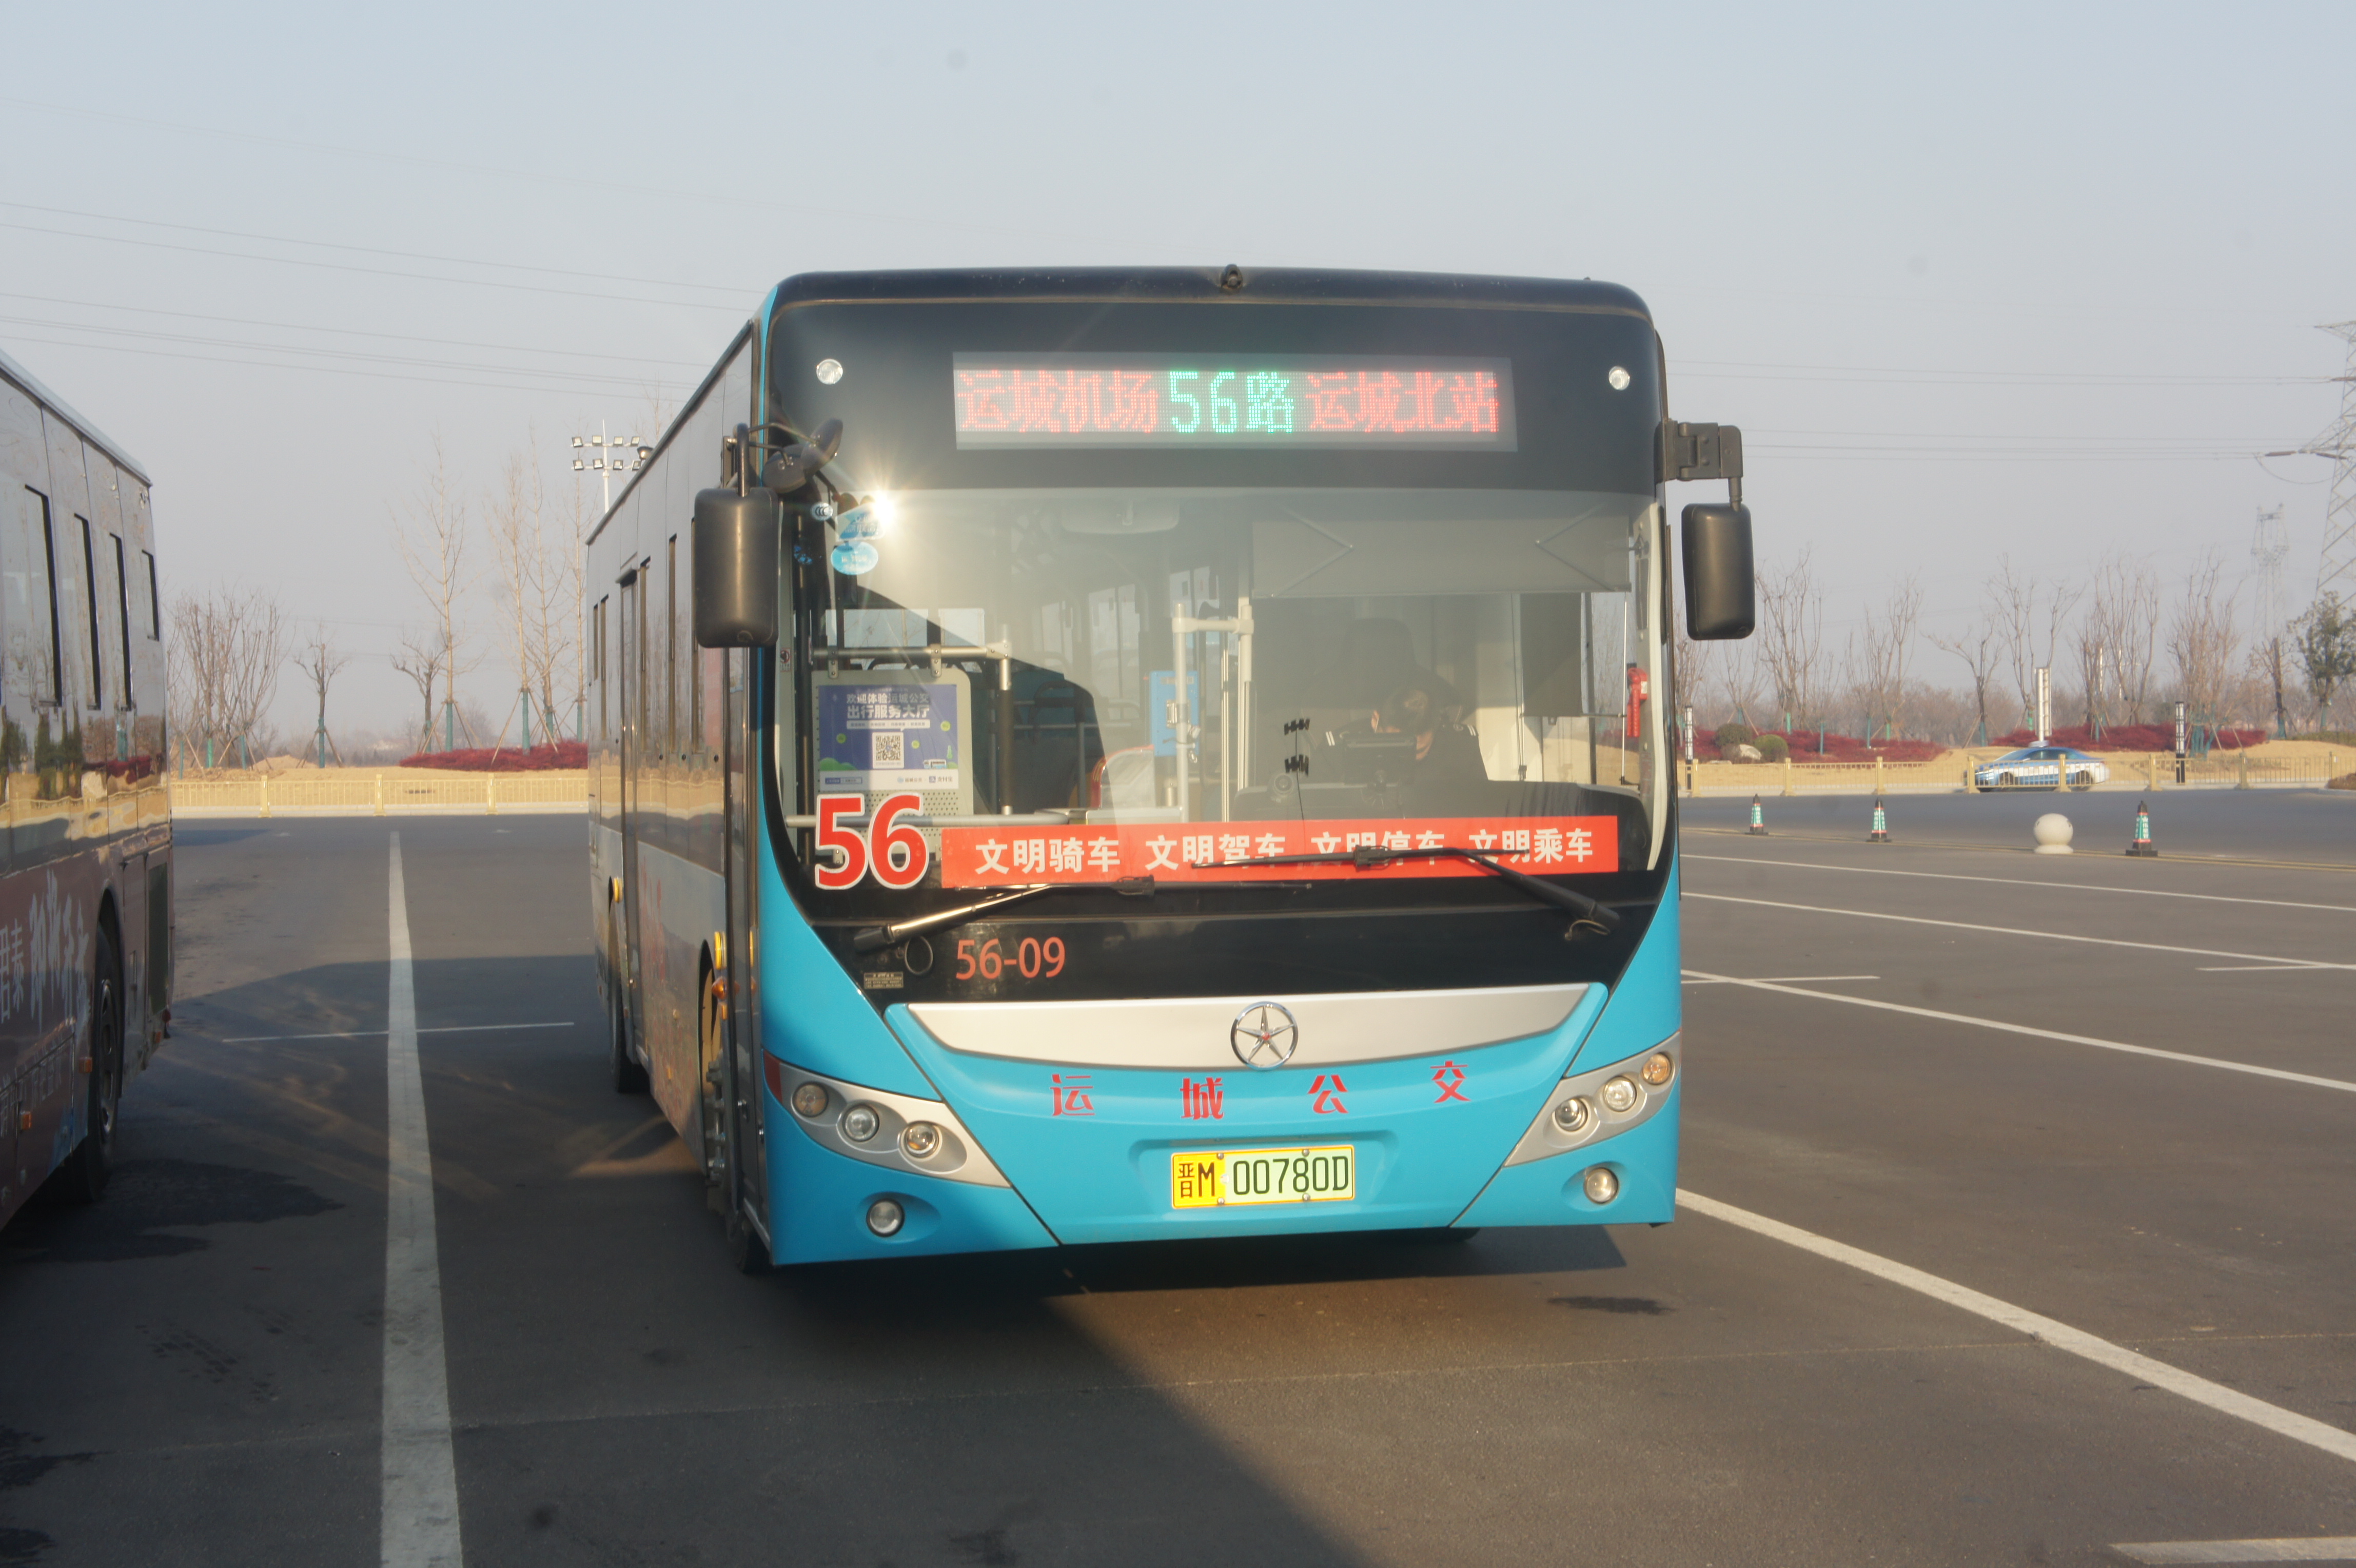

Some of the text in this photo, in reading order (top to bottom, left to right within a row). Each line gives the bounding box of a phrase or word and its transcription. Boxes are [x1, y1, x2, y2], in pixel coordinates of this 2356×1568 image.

[957, 370, 1499, 433] 运城机场 56路 运城北站
[847, 693, 930, 703] 欢迎体验运城公交
[847, 704, 930, 718] 出行服务大厅
[816, 793, 929, 890] 56
[975, 836, 1120, 874] 文明骑车
[1145, 833, 1285, 870] 文明驾车
[1468, 828, 1593, 864] 文明乘车
[956, 937, 1066, 979] 56-09
[1177, 1155, 1348, 1198] 晋M 00780D
